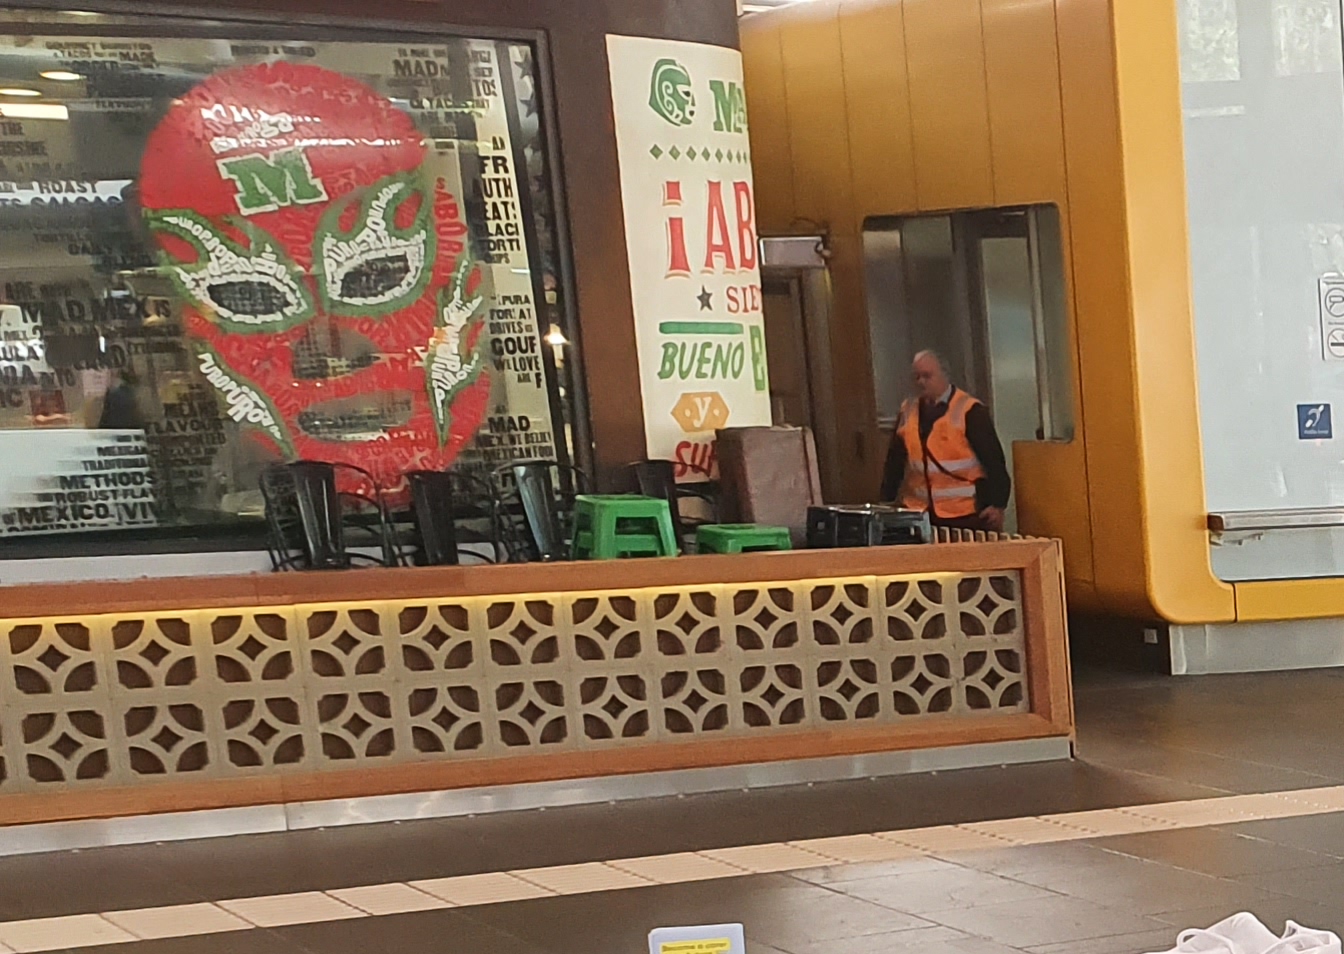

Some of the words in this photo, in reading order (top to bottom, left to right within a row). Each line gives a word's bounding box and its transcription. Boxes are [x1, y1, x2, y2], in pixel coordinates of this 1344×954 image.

[216, 146, 329, 216] M
[657, 341, 745, 380] BUENO
[488, 415, 531, 433] MAD
[58, 471, 158, 489] METHODS
